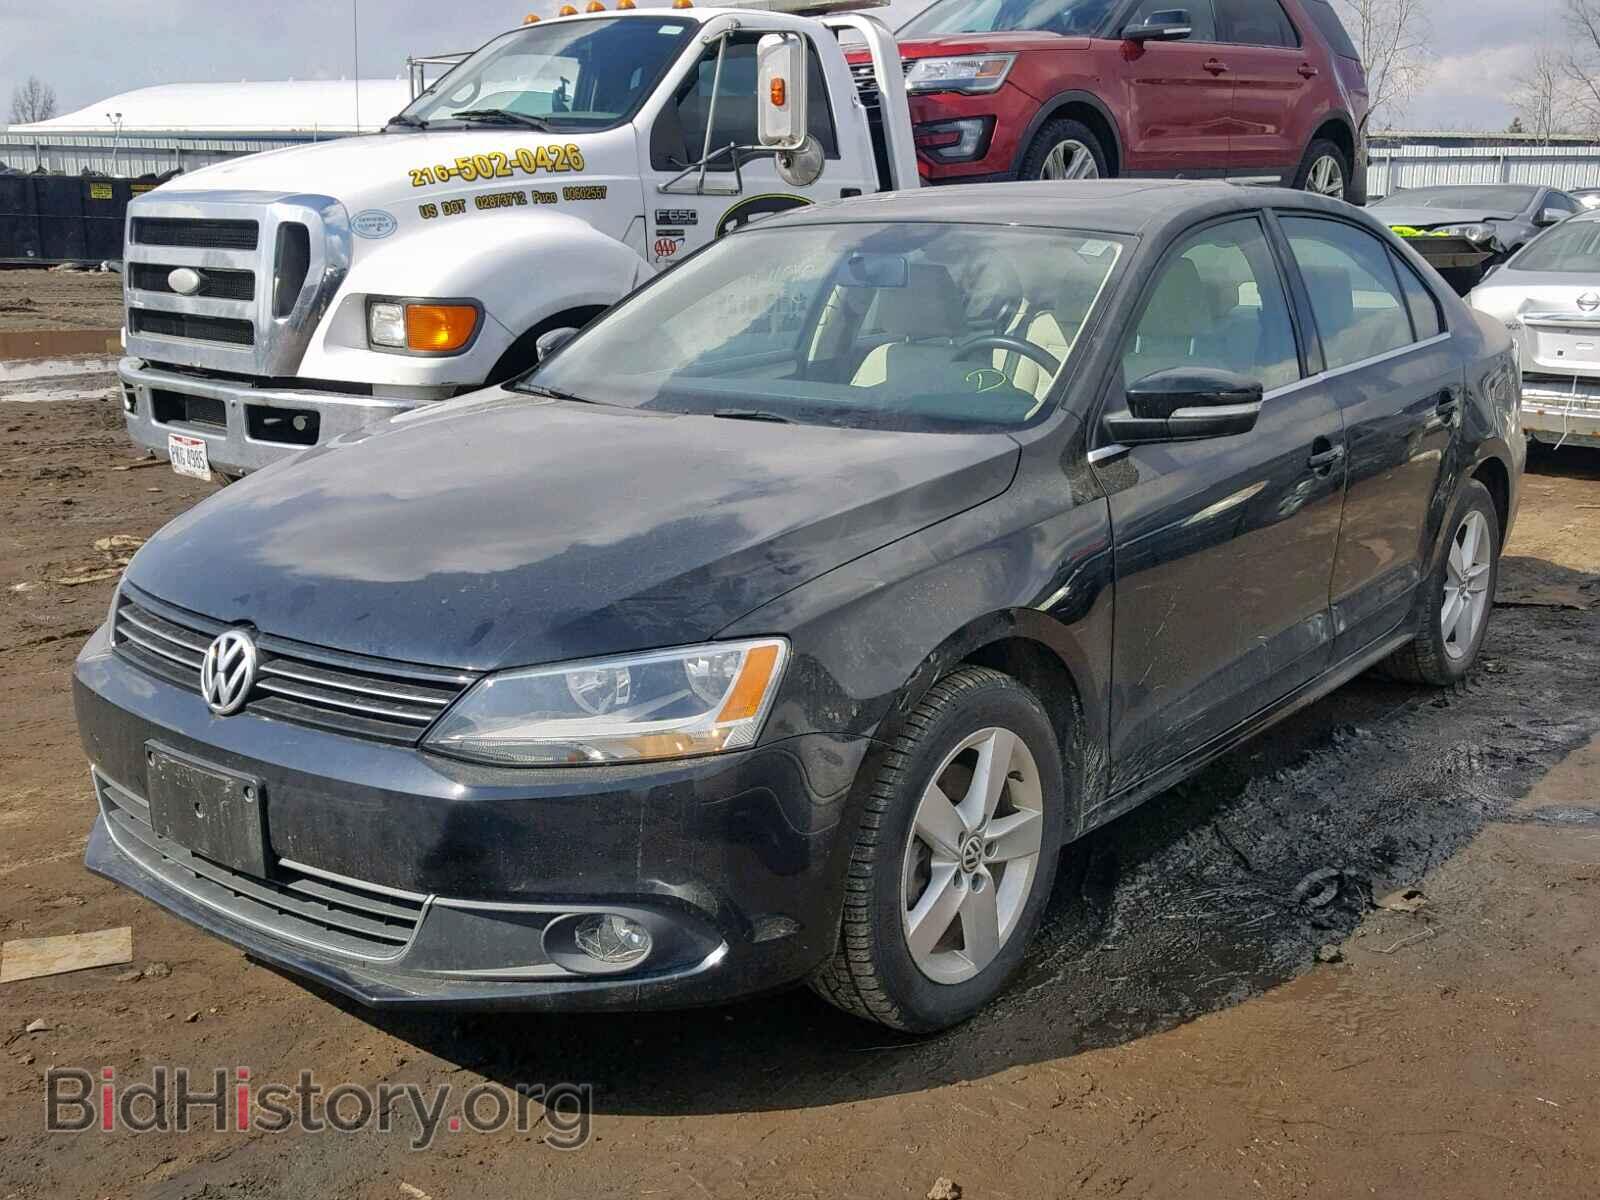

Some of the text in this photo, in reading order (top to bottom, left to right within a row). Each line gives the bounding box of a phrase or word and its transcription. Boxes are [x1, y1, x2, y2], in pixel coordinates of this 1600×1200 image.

[409, 143, 585, 187] 216-502-0426
[418, 203, 438, 219] US
[441, 199, 466, 216] DOT
[656, 210, 698, 221] F650
[656, 239, 676, 251] AAA
[966, 368, 1006, 394] D
